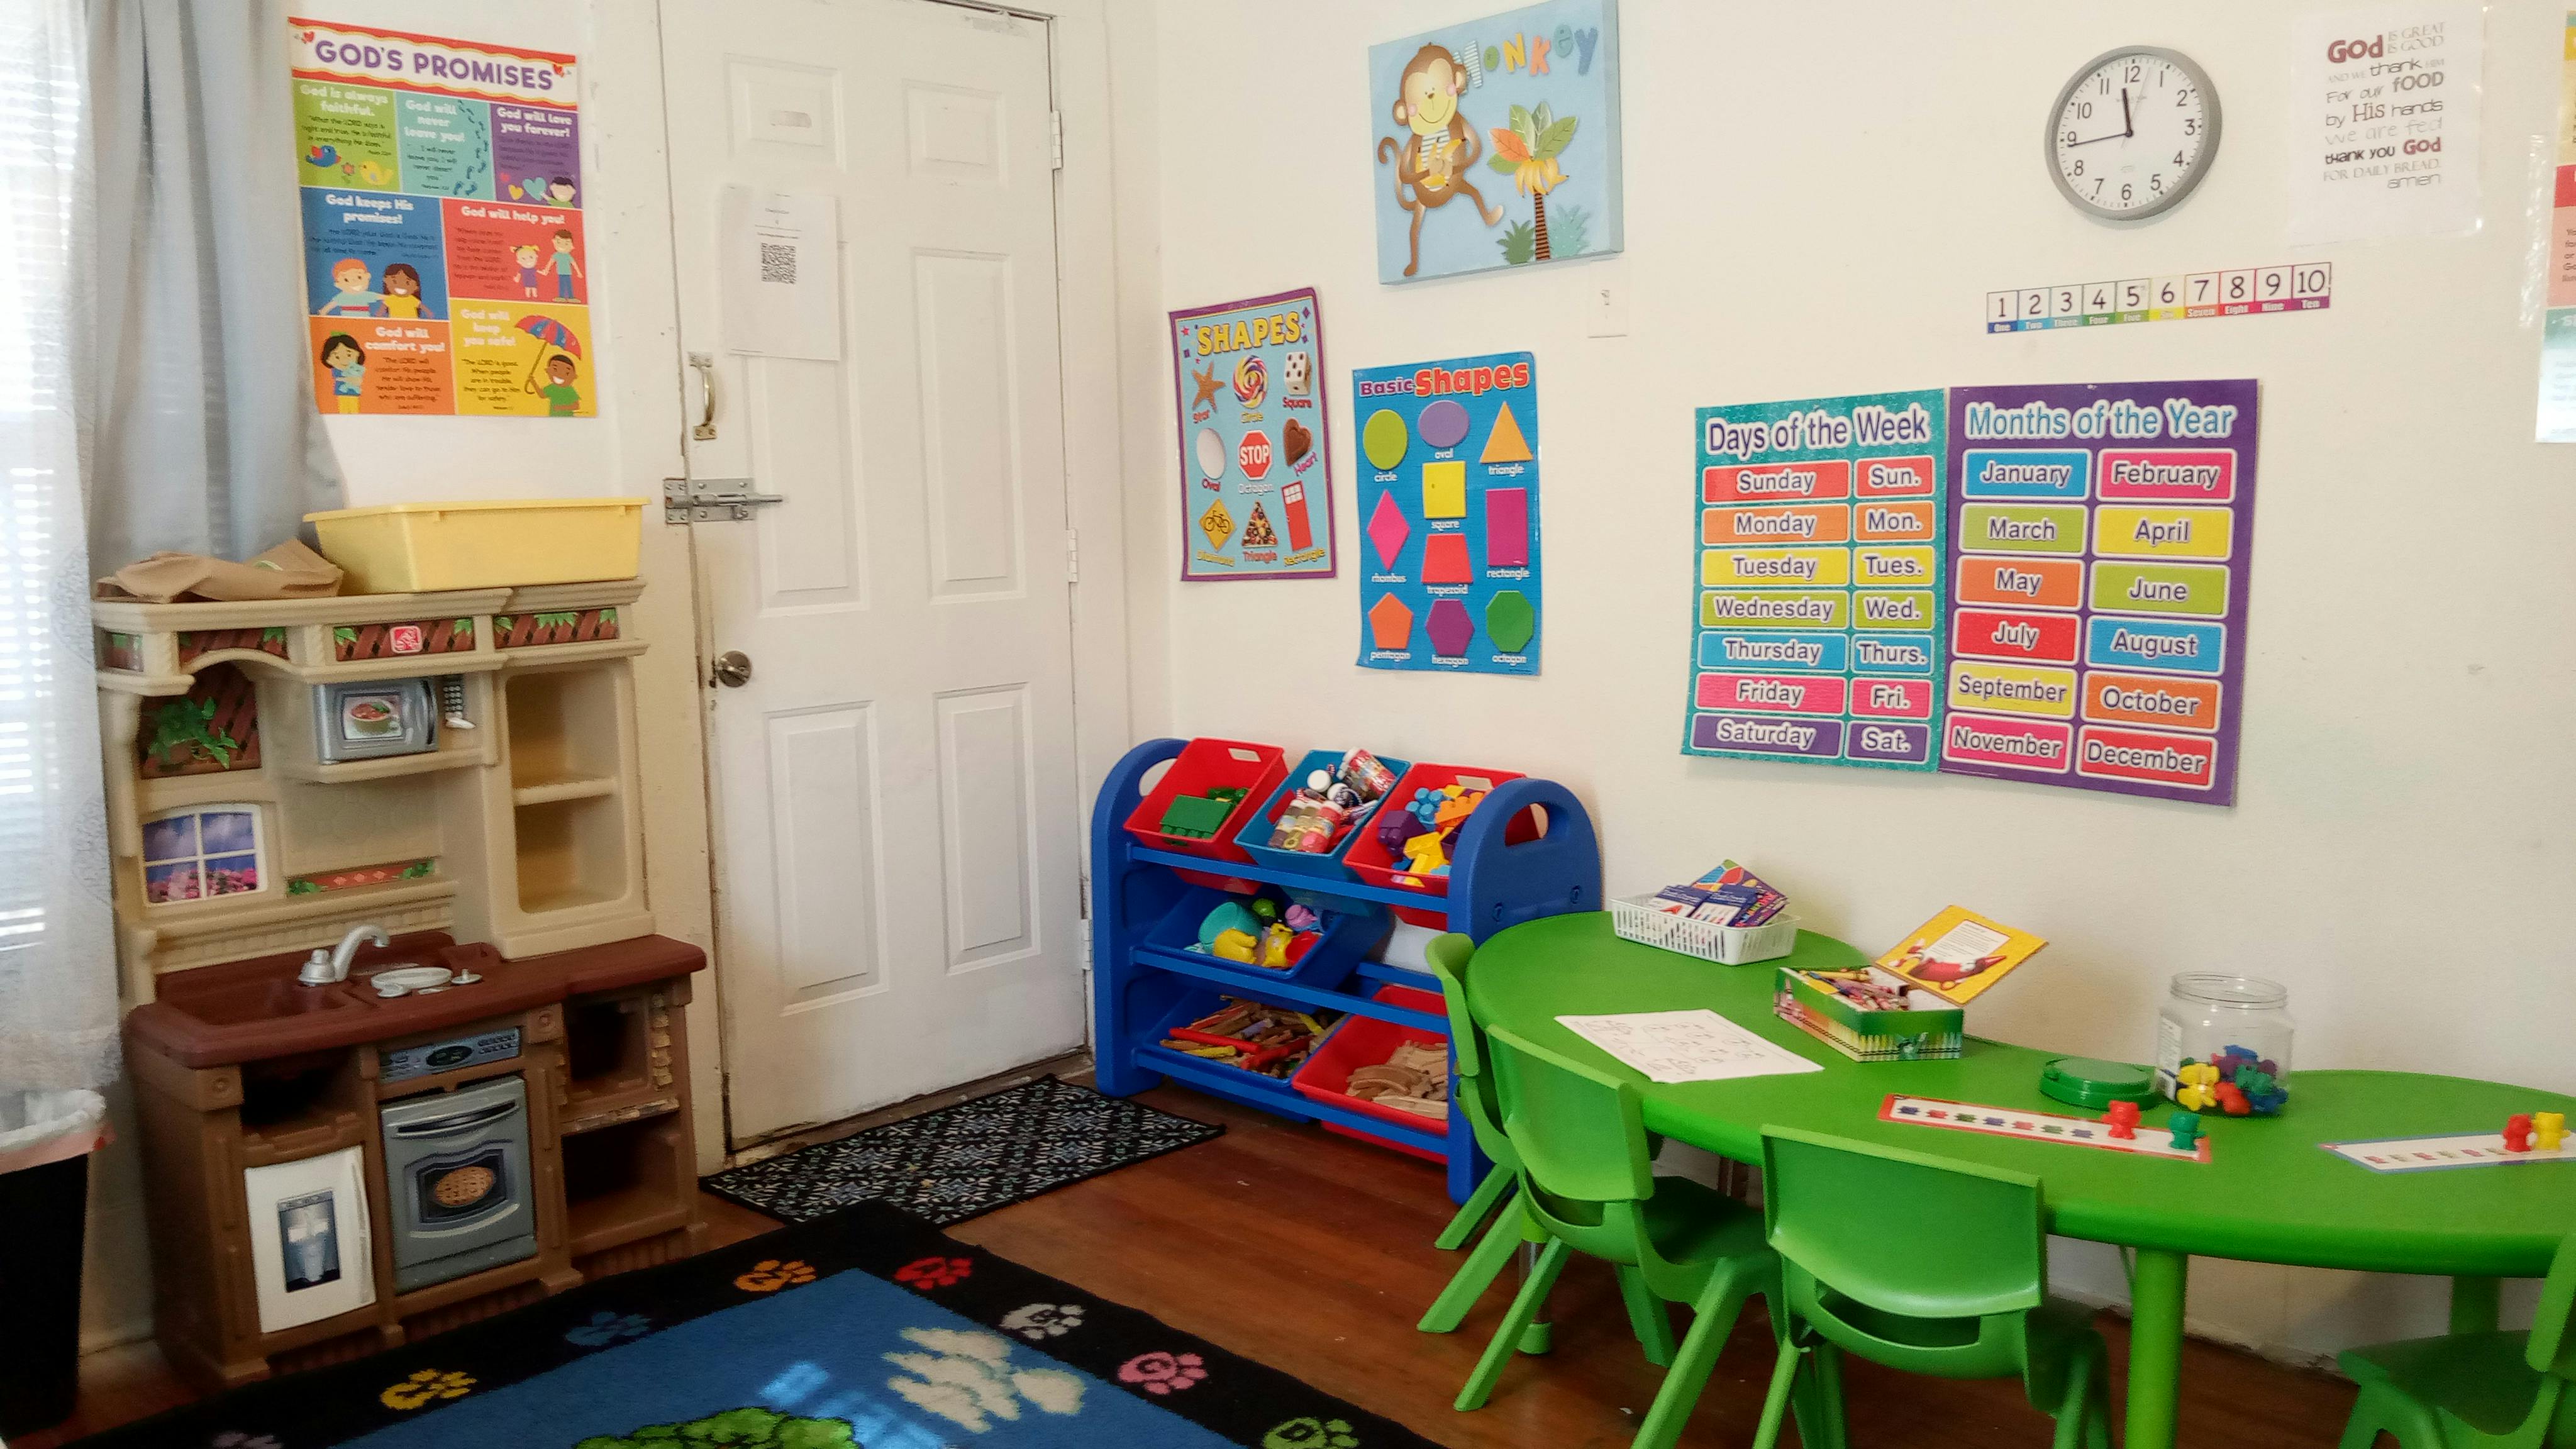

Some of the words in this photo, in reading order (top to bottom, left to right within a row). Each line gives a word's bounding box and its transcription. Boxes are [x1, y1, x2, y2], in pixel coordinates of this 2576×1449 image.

[2401, 21, 2446, 39] GREAT
[2401, 35, 2444, 52] GOOD
[316, 40, 402, 71] GOD'S
[413, 52, 553, 90] PROMISES
[2125, 65, 2140, 83] 12
[2370, 58, 2423, 77] thank
[2101, 78, 2109, 95] 11
[2159, 70, 2163, 87] 1
[300, 85, 327, 97] God
[330, 86, 341, 98] is
[345, 91, 388, 106] always
[2176, 89, 2187, 106] 2
[406, 100, 431, 111] God
[434, 104, 457, 115] will
[497, 107, 521, 119] God
[523, 111, 546, 123] will
[548, 113, 572, 125] love
[2077, 102, 2092, 119] 10
[2326, 114, 2346, 128] by
[2352, 103, 2385, 122] His
[2392, 99, 2443, 116] hands
[418, 116, 450, 126] never
[501, 122, 523, 134] you
[524, 123, 570, 138] forever!
[2184, 118, 2196, 136] 3
[404, 126, 436, 138] leave
[2067, 131, 2077, 147] 9
[2325, 130, 2357, 145] we
[2366, 125, 2398, 140] are
[2405, 117, 2442, 136] fed
[2173, 150, 2184, 167] 4
[2325, 150, 2365, 164] thank
[2074, 160, 2084, 176] 8
[2324, 167, 2348, 181] FOR
[2353, 164, 2390, 179] DAILY
[2094, 178, 2105, 194] 7
[2150, 174, 2162, 191] 5
[2387, 174, 2440, 189] amen
[2121, 184, 2131, 200] 6
[325, 194, 354, 206] God
[355, 196, 392, 211] keeps
[394, 199, 414, 211] His
[343, 212, 402, 225] promises!
[461, 206, 486, 218] God
[487, 208, 511, 220] will
[512, 210, 539, 225] help
[541, 214, 565, 226] you!
[1999, 297, 2006, 317] 1
[2029, 294, 2043, 314] 2
[2060, 292, 2072, 312] 3
[2092, 289, 2106, 309] 4
[2126, 286, 2140, 307] 5
[2161, 282, 2174, 303] 6
[2194, 279, 2210, 301] 7
[2231, 275, 2245, 299] 8
[2266, 273, 2280, 296] 9
[2297, 270, 2325, 293] 10
[461, 309, 486, 319] God
[488, 311, 510, 321] will
[1994, 323, 2011, 332] One
[2026, 321, 2043, 330] Two
[2089, 316, 2109, 325] Four
[2187, 308, 2215, 317] Seven
[2224, 304, 2249, 314] Eight
[2301, 299, 2321, 309] Ten
[375, 326, 402, 338] God
[404, 328, 430, 339] will
[473, 323, 501, 335] keep
[1197, 311, 1301, 357] SHAPES
[365, 340, 417, 352] comfort
[419, 341, 445, 354] you!
[464, 337, 485, 348] you
[487, 336, 516, 347] safe!
[1359, 377, 1414, 397] Basic
[1414, 362, 1530, 397] Shapes
[1282, 396, 1313, 409] Square
[1193, 409, 1211, 424] Star
[1240, 411, 1263, 424] Circle
[1968, 405, 2067, 437] Months
[2077, 404, 2106, 435] of
[2113, 404, 2158, 435] the
[2168, 402, 2233, 435] Year
[1708, 419, 1765, 457] Days
[1774, 416, 1799, 448] of
[1808, 413, 1848, 445] the
[1856, 405, 1927, 442] Week
[1240, 445, 1269, 467] STOP
[1435, 449, 1454, 460] oval
[1293, 451, 1319, 477] Heart
[1374, 472, 1398, 483] circle
[1488, 464, 1526, 477] triangle
[1738, 471, 1816, 495] Sunday
[1869, 467, 1920, 487] Sun.
[1981, 462, 2070, 486] January
[2112, 462, 2220, 489] February
[1202, 478, 1221, 492] Oval
[1238, 482, 1275, 496] Octagon
[1431, 519, 1460, 531] square
[1736, 514, 1815, 538] Monday
[1867, 511, 1921, 531] Mon.
[1988, 518, 2055, 540] March
[2134, 519, 2190, 545] April
[1242, 550, 1279, 565] Triangle
[1284, 547, 1326, 567] Rectangle
[1486, 567, 1531, 580] rectangle
[1733, 555, 1817, 579] Tuesday
[1864, 555, 1923, 575] Tues.
[1996, 570, 2041, 594] May
[2129, 578, 2188, 602] June
[1714, 598, 1834, 623] Wednesday
[1865, 597, 1921, 619] Wed.
[1992, 623, 2038, 649] July
[2112, 630, 2197, 658] August
[1370, 650, 1411, 662] pentagon
[1431, 654, 1469, 667] hexagon
[1492, 653, 1527, 665] octagon
[1724, 639, 1821, 663] Thursday
[1859, 642, 1928, 664] Thurs.
[1737, 681, 1804, 706] Friday
[1872, 686, 1910, 708] Fri.
[1958, 674, 2067, 702] September
[2103, 686, 2200, 715] October
[1717, 720, 1814, 748] Saturday
[1863, 727, 1911, 752] Sat.
[1953, 728, 2061, 757] November
[2087, 741, 2205, 773] December
